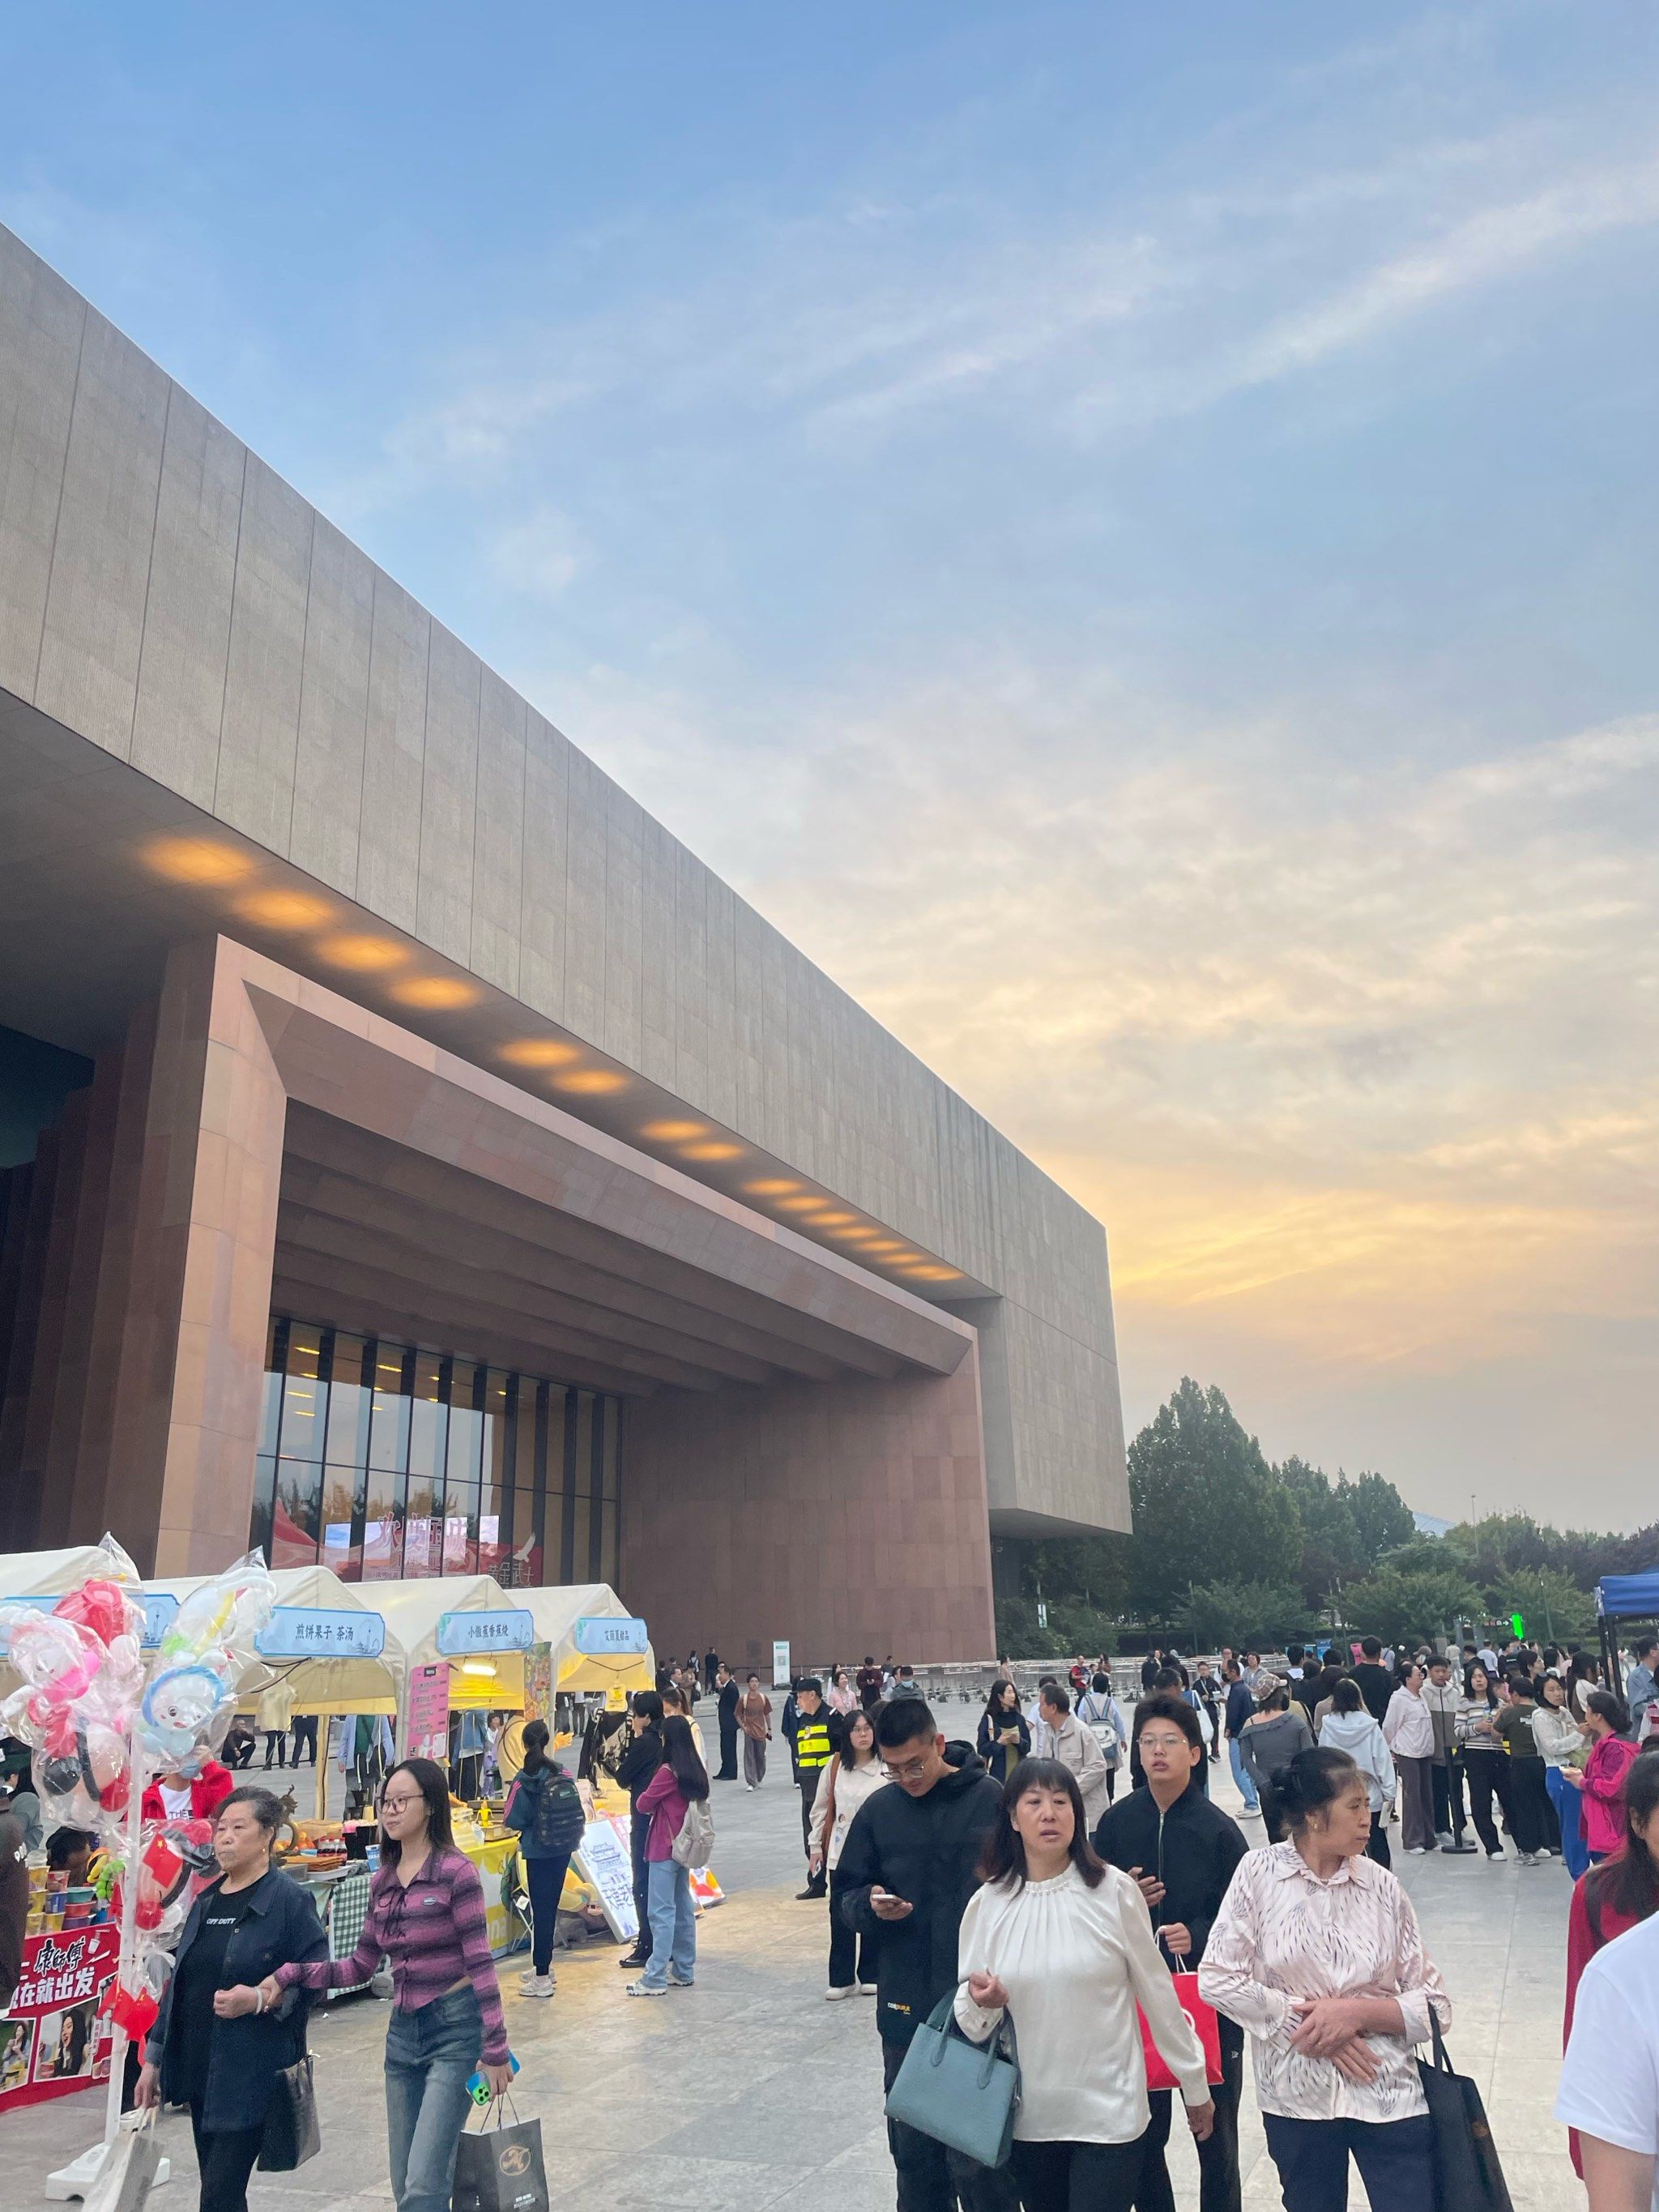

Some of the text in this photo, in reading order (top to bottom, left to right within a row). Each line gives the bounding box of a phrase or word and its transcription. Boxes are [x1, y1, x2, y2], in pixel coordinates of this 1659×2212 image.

[295, 1623, 354, 1642] 煎饼果子 茶汤
[168, 1809, 188, 1820] THE
[218, 1917, 237, 1925] DUTY
[34, 1937, 86, 1977] 康師傅
